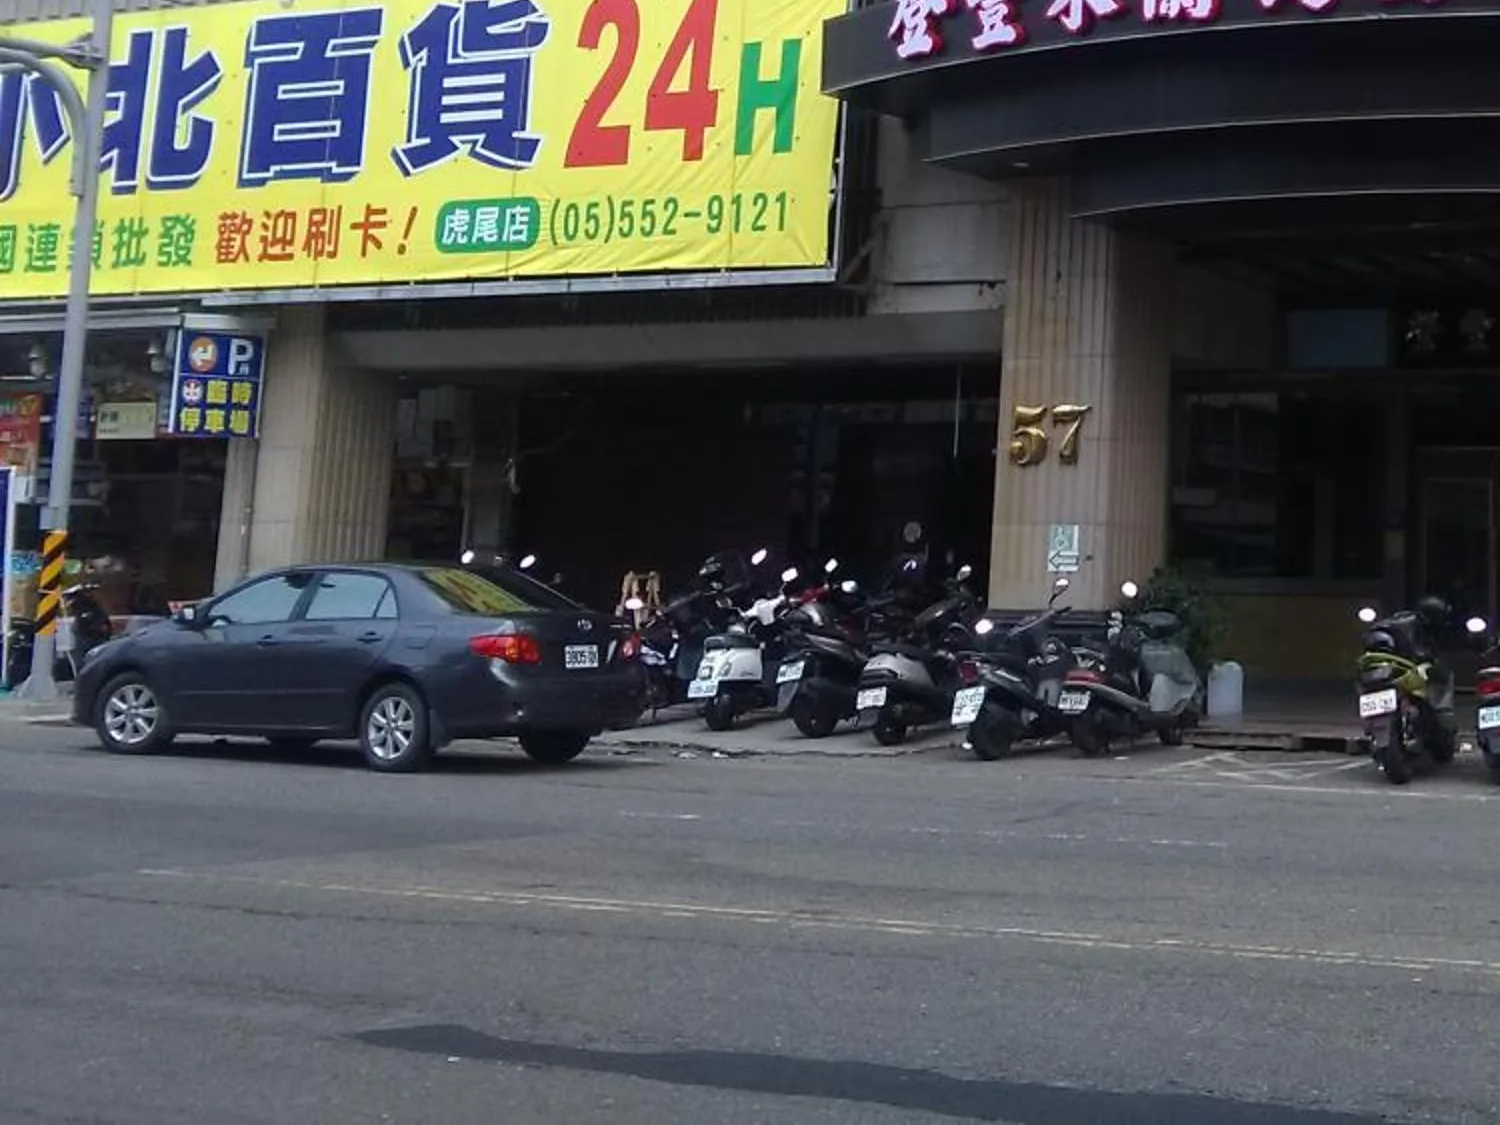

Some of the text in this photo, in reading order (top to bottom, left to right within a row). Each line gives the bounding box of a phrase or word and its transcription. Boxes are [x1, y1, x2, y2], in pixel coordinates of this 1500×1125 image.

[441, 205, 531, 244] 虎尾店
[550, 190, 788, 246] (05)552-9121
[1009, 404, 1092, 467] 57
